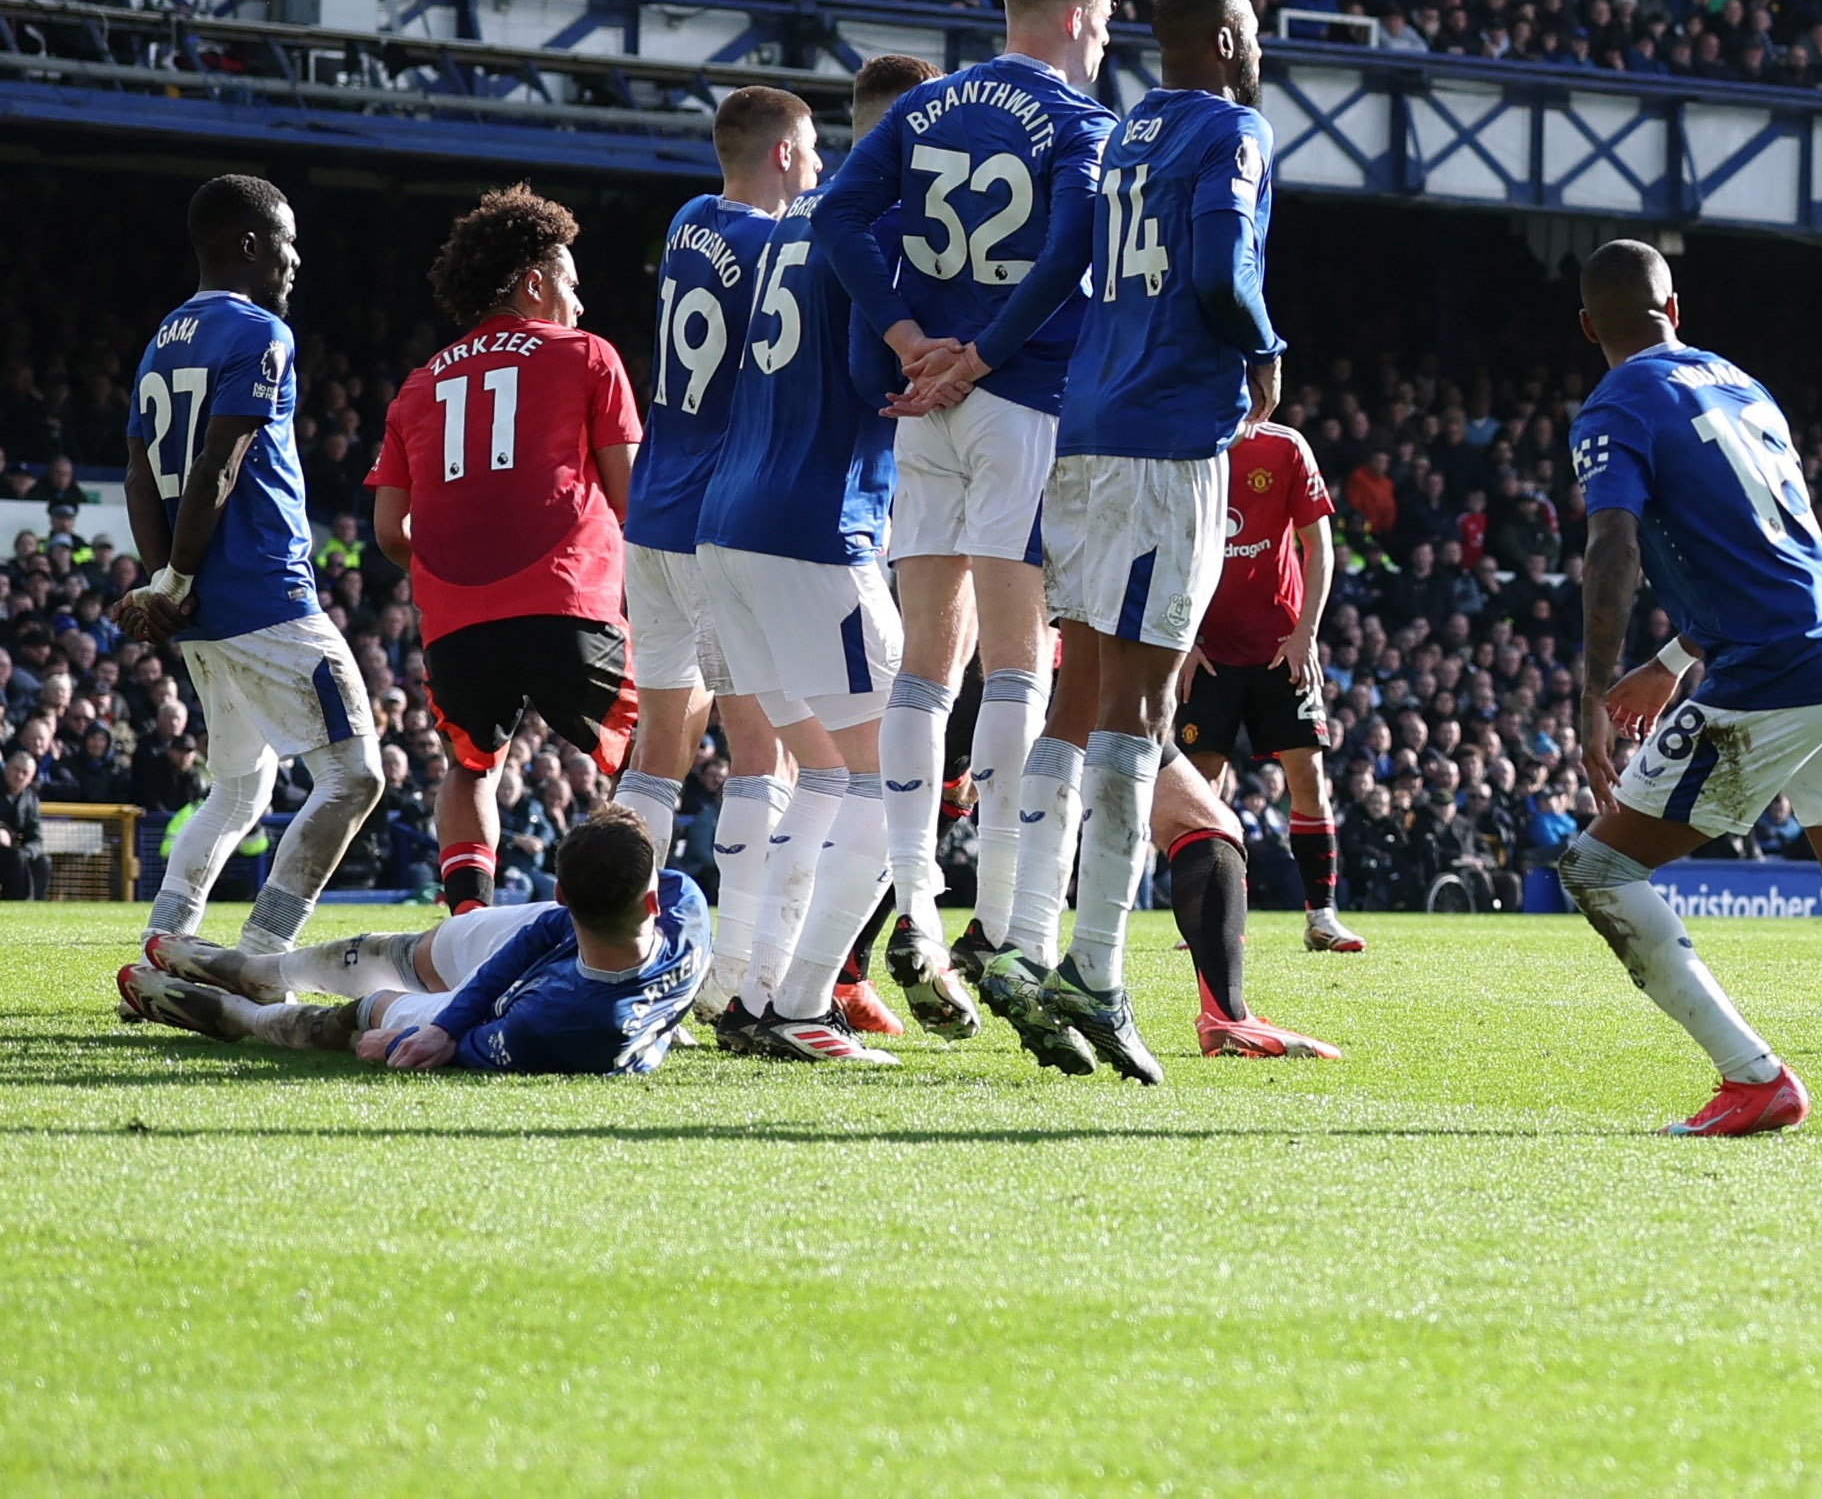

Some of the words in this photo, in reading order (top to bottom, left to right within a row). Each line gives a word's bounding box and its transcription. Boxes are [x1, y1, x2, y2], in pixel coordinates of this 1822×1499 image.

[906, 81, 1053, 157] BRANTHWAITE
[1121, 116, 1163, 147] BETO
[902, 144, 1036, 285] 32
[1102, 163, 1168, 302] 14
[157, 317, 199, 349] GANA
[653, 276, 727, 415] 19
[739, 240, 811, 375] 15
[430, 332, 543, 377] ZIRKZEE
[139, 367, 208, 500] 27
[436, 366, 519, 483] 11
[1225, 537, 1272, 558] dragon
[1648, 705, 1706, 760] 8
[620, 945, 702, 1037] GARNER
